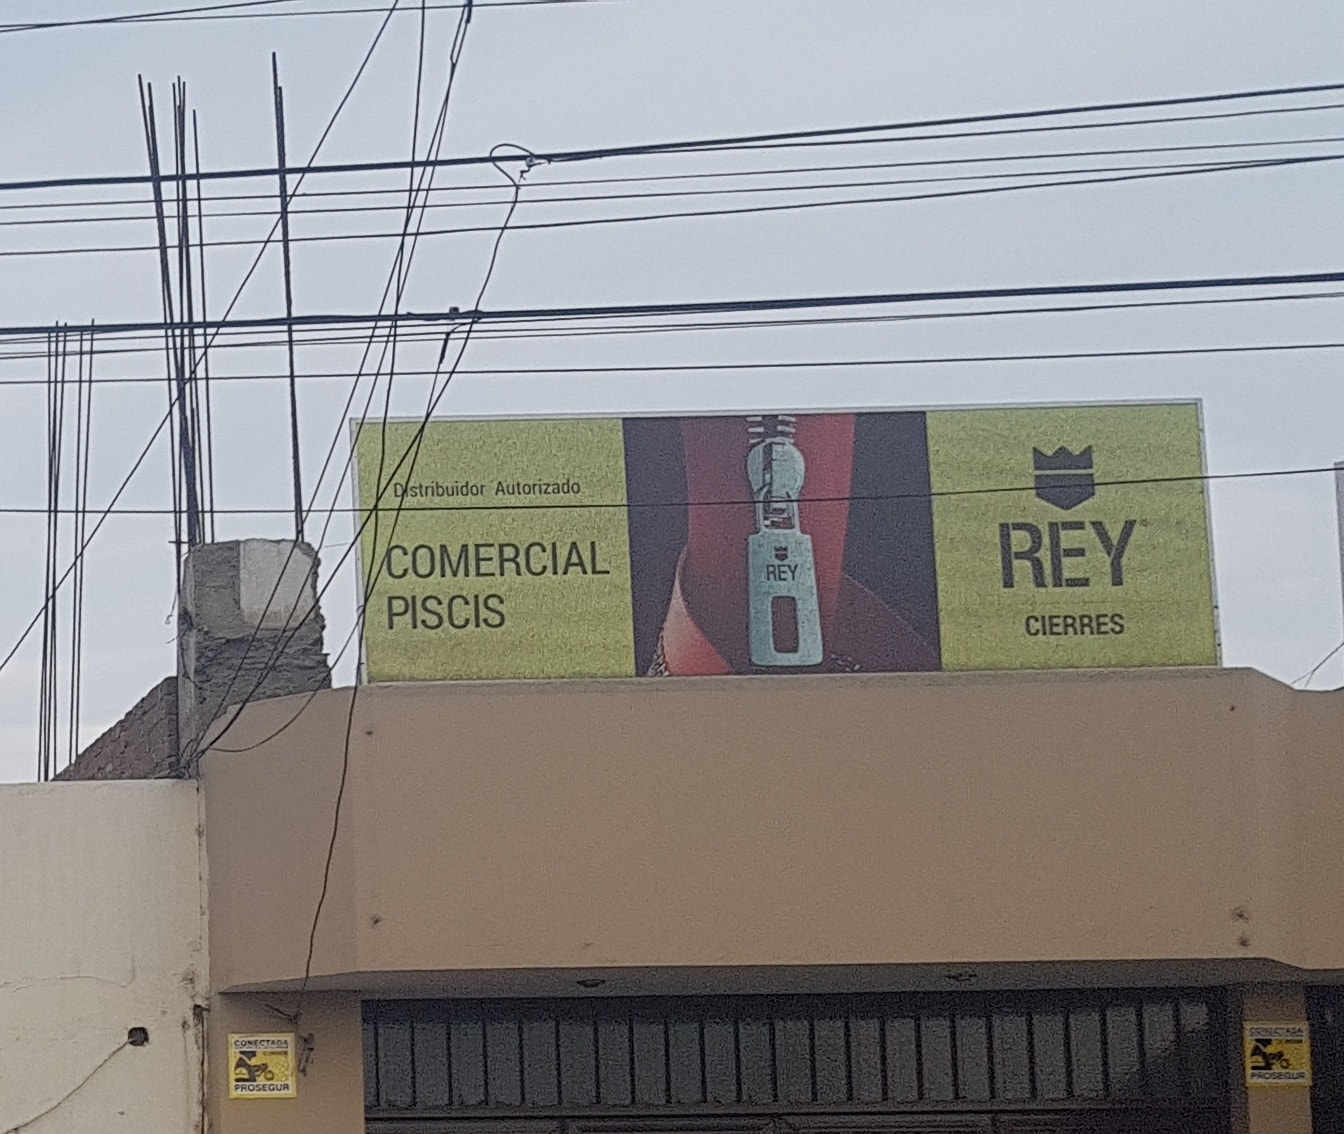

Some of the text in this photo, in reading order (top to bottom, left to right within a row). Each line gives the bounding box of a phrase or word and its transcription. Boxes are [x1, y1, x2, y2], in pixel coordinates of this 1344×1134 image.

[393, 478, 582, 498] Distribuidor Autorizado
[386, 540, 611, 580] COMERCIAL
[998, 519, 1137, 588] REY
[766, 563, 799, 582] REY
[387, 593, 506, 630] PISCIS
[1024, 613, 1126, 637] CIERRES
[234, 1083, 290, 1092] PROSEGUR
